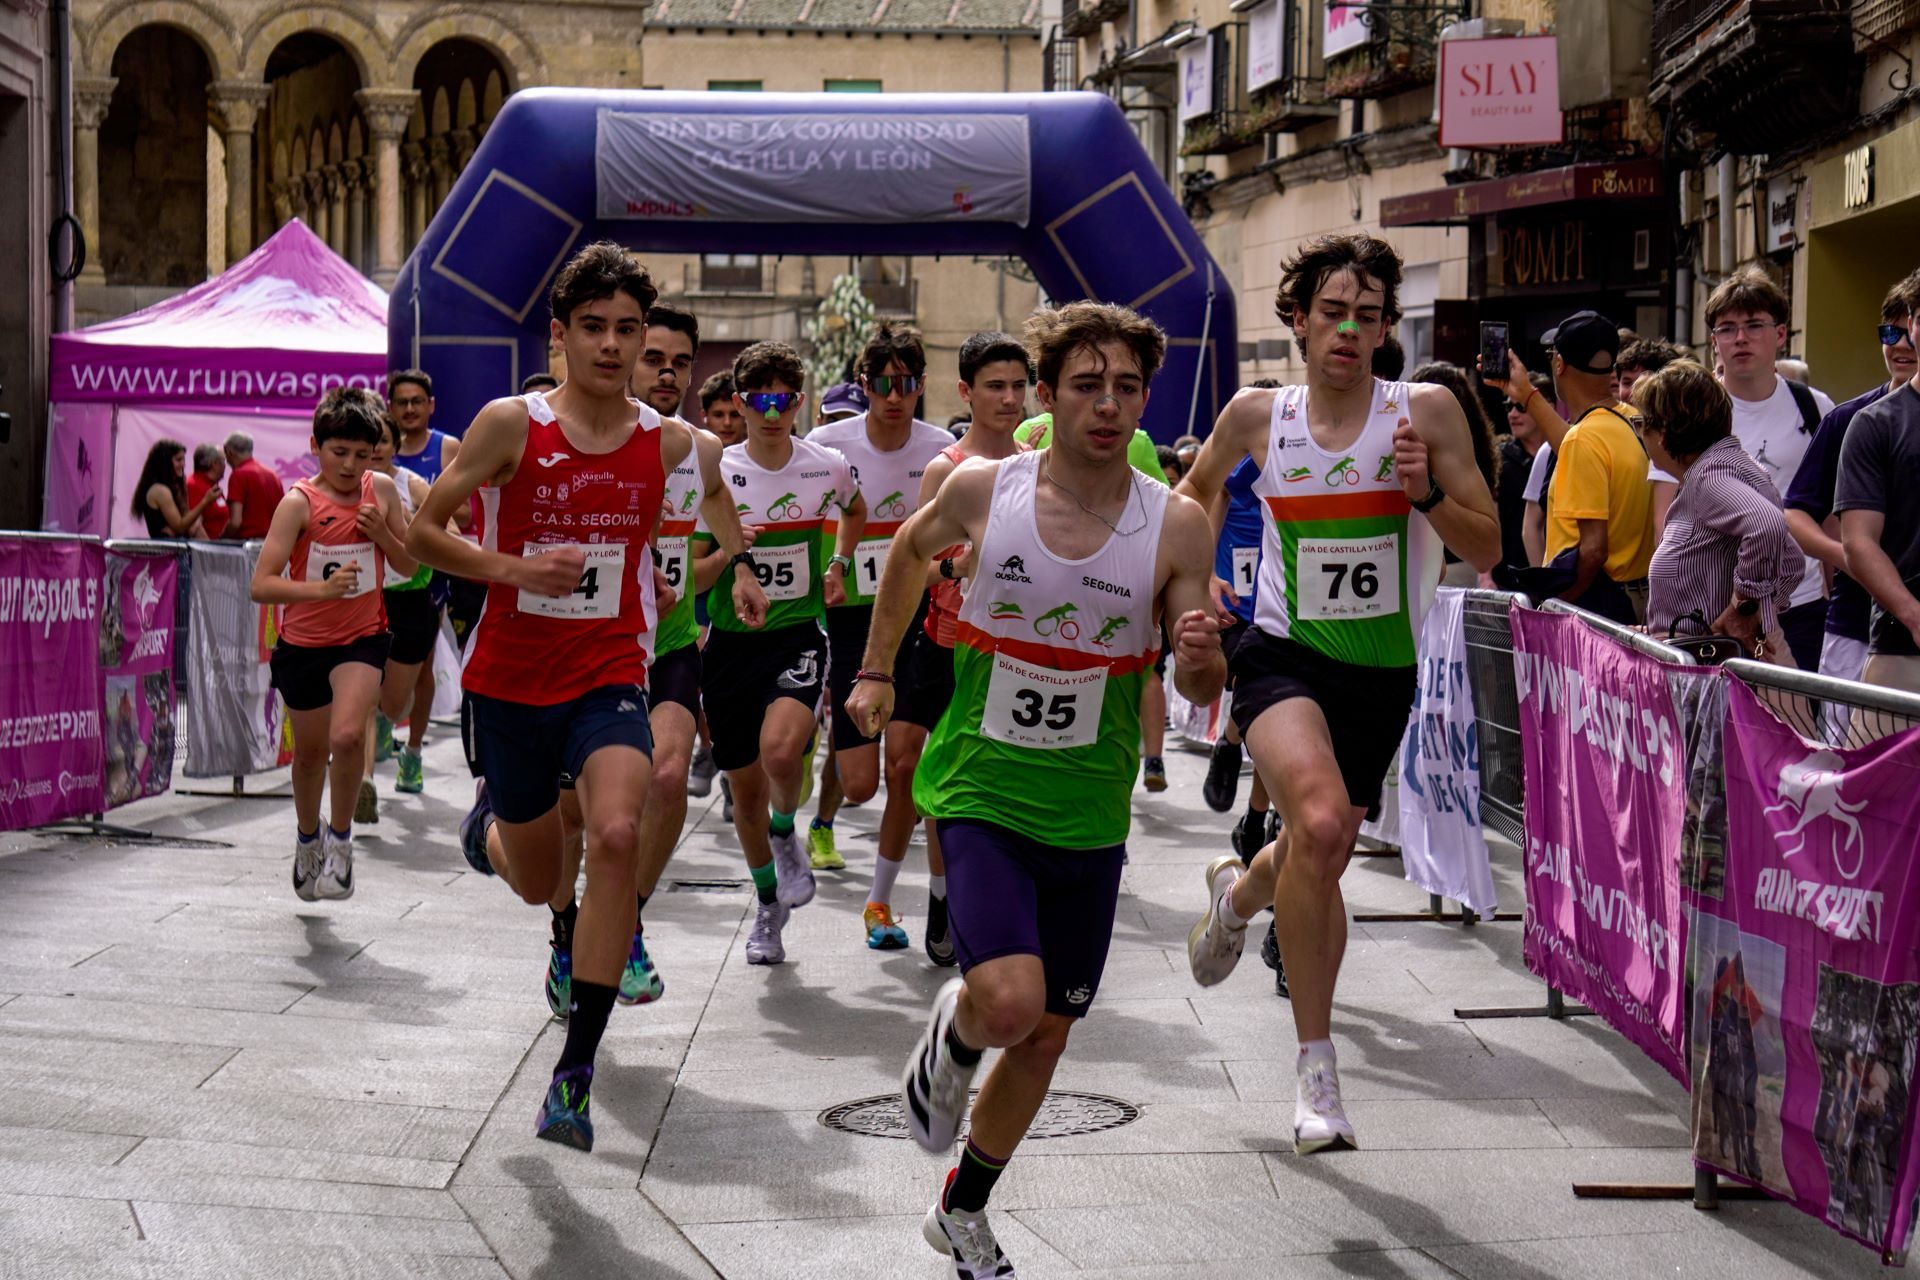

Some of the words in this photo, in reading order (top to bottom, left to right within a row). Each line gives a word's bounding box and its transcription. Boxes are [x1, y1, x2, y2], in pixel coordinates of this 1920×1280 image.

[1460, 61, 1545, 96] SLAY
[1471, 106, 1510, 117] BEAUTY
[1513, 105, 1533, 115] BAR
[705, 122, 745, 139] DE
[752, 121, 787, 140] LA
[793, 121, 976, 141] COMUNIDAD
[692, 150, 823, 171] CASTILLA
[829, 150, 847, 171] Y
[855, 145, 932, 171] LEÓN
[1592, 172, 1655, 195] POMPI
[1844, 146, 1870, 208] TOUS
[1499, 220, 1585, 287] POMPI
[581, 471, 615, 482] Magullo
[801, 470, 830, 480] SEGOVIA
[532, 512, 576, 526] C.A.S.
[581, 513, 640, 526] SEGOVIA
[1302, 544, 1316, 554] DÍA
[1329, 545, 1366, 554] CASTILLA
[1374, 541, 1394, 551] LEÓN
[753, 562, 794, 587] 95
[1321, 562, 1379, 600] 76
[1082, 576, 1131, 598] SEGOVIA
[999, 660, 1014, 673] DÍA
[1015, 667, 1027, 677] DE
[1028, 671, 1070, 685] CASTILLA
[1079, 672, 1101, 684] LEÓN
[1012, 688, 1077, 731] 35
